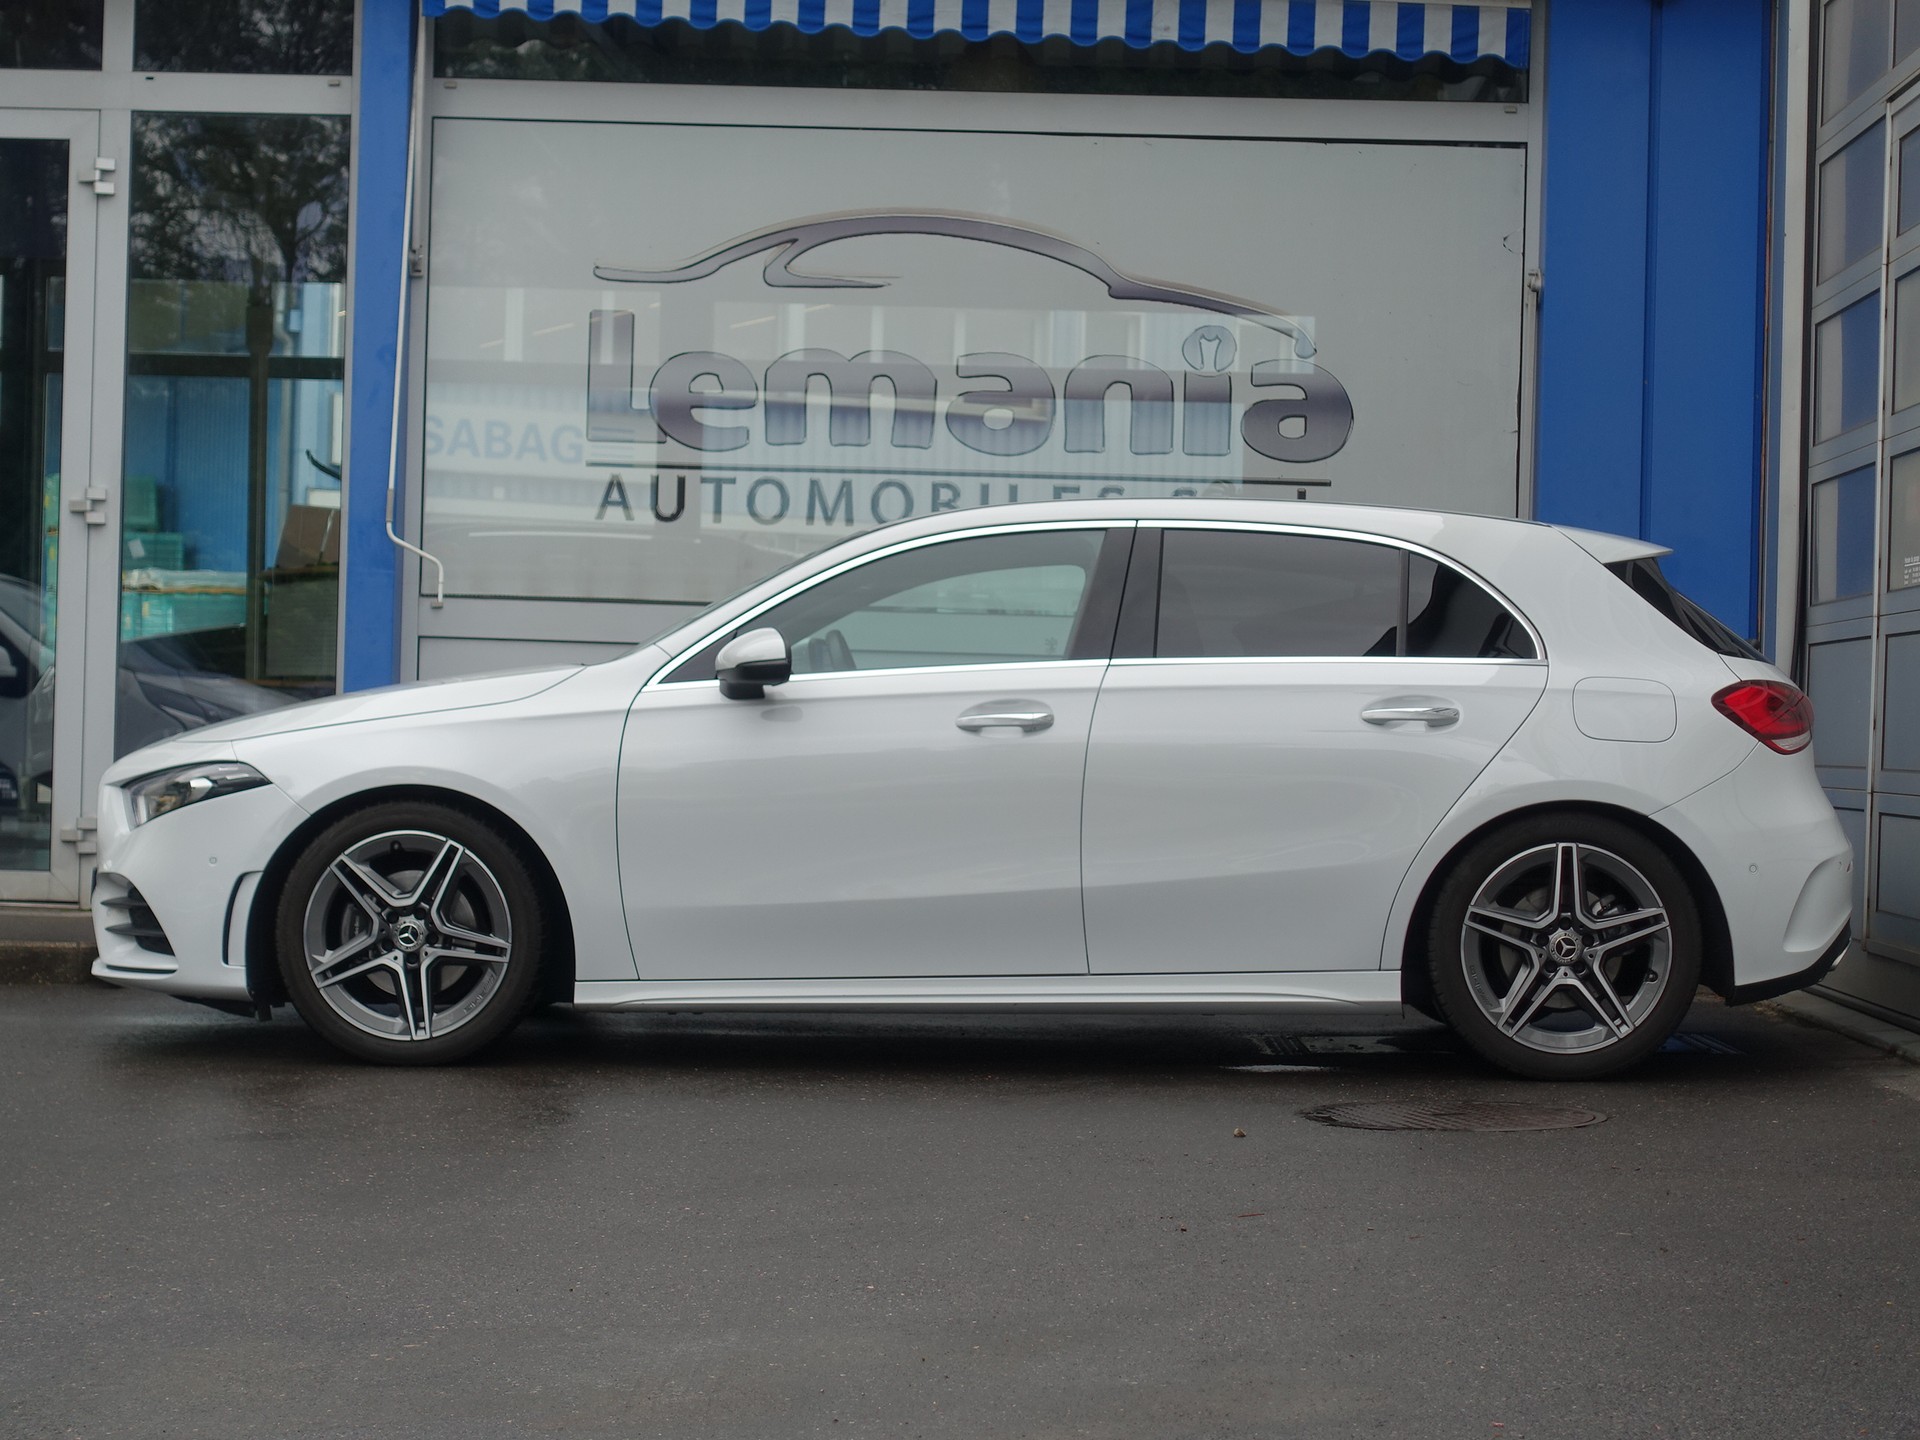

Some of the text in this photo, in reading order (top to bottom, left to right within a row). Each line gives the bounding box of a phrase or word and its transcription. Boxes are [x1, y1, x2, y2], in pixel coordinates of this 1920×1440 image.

[586, 309, 1354, 463] Lemania
[425, 414, 585, 465] SABAG
[594, 473, 1126, 527] AUTOMOB
